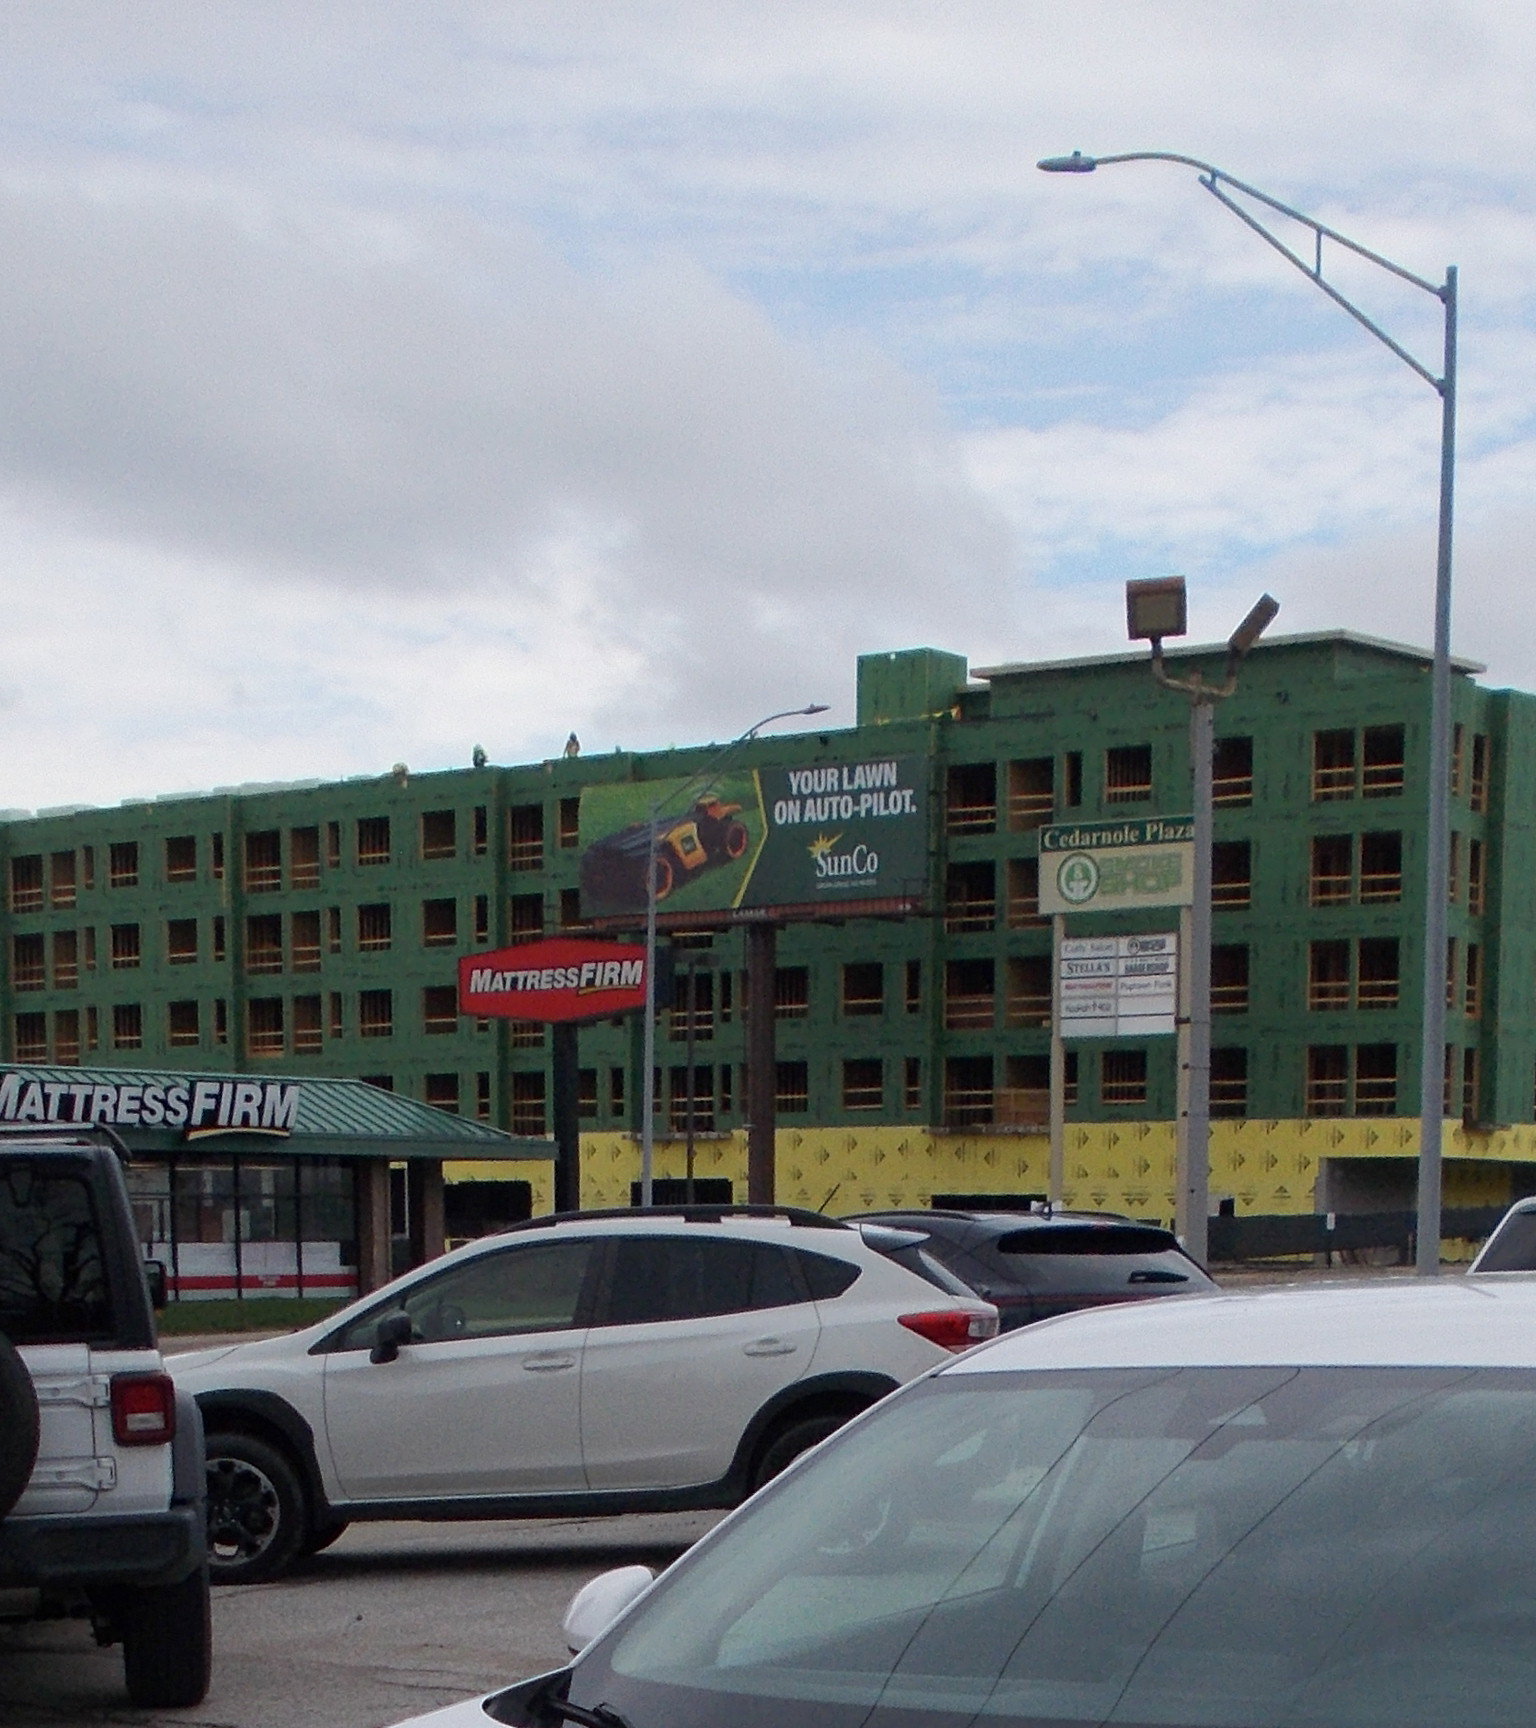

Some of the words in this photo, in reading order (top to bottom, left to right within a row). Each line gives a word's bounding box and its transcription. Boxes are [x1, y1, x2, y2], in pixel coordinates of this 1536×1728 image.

[789, 768, 839, 796] YOUR
[843, 762, 897, 791] LAWN
[774, 800, 800, 825] ON
[804, 789, 917, 823] AUTO-PILOT.
[1043, 825, 1140, 850] Cedarnole
[1146, 822, 1195, 842] Plaza
[816, 844, 878, 877] SunCo
